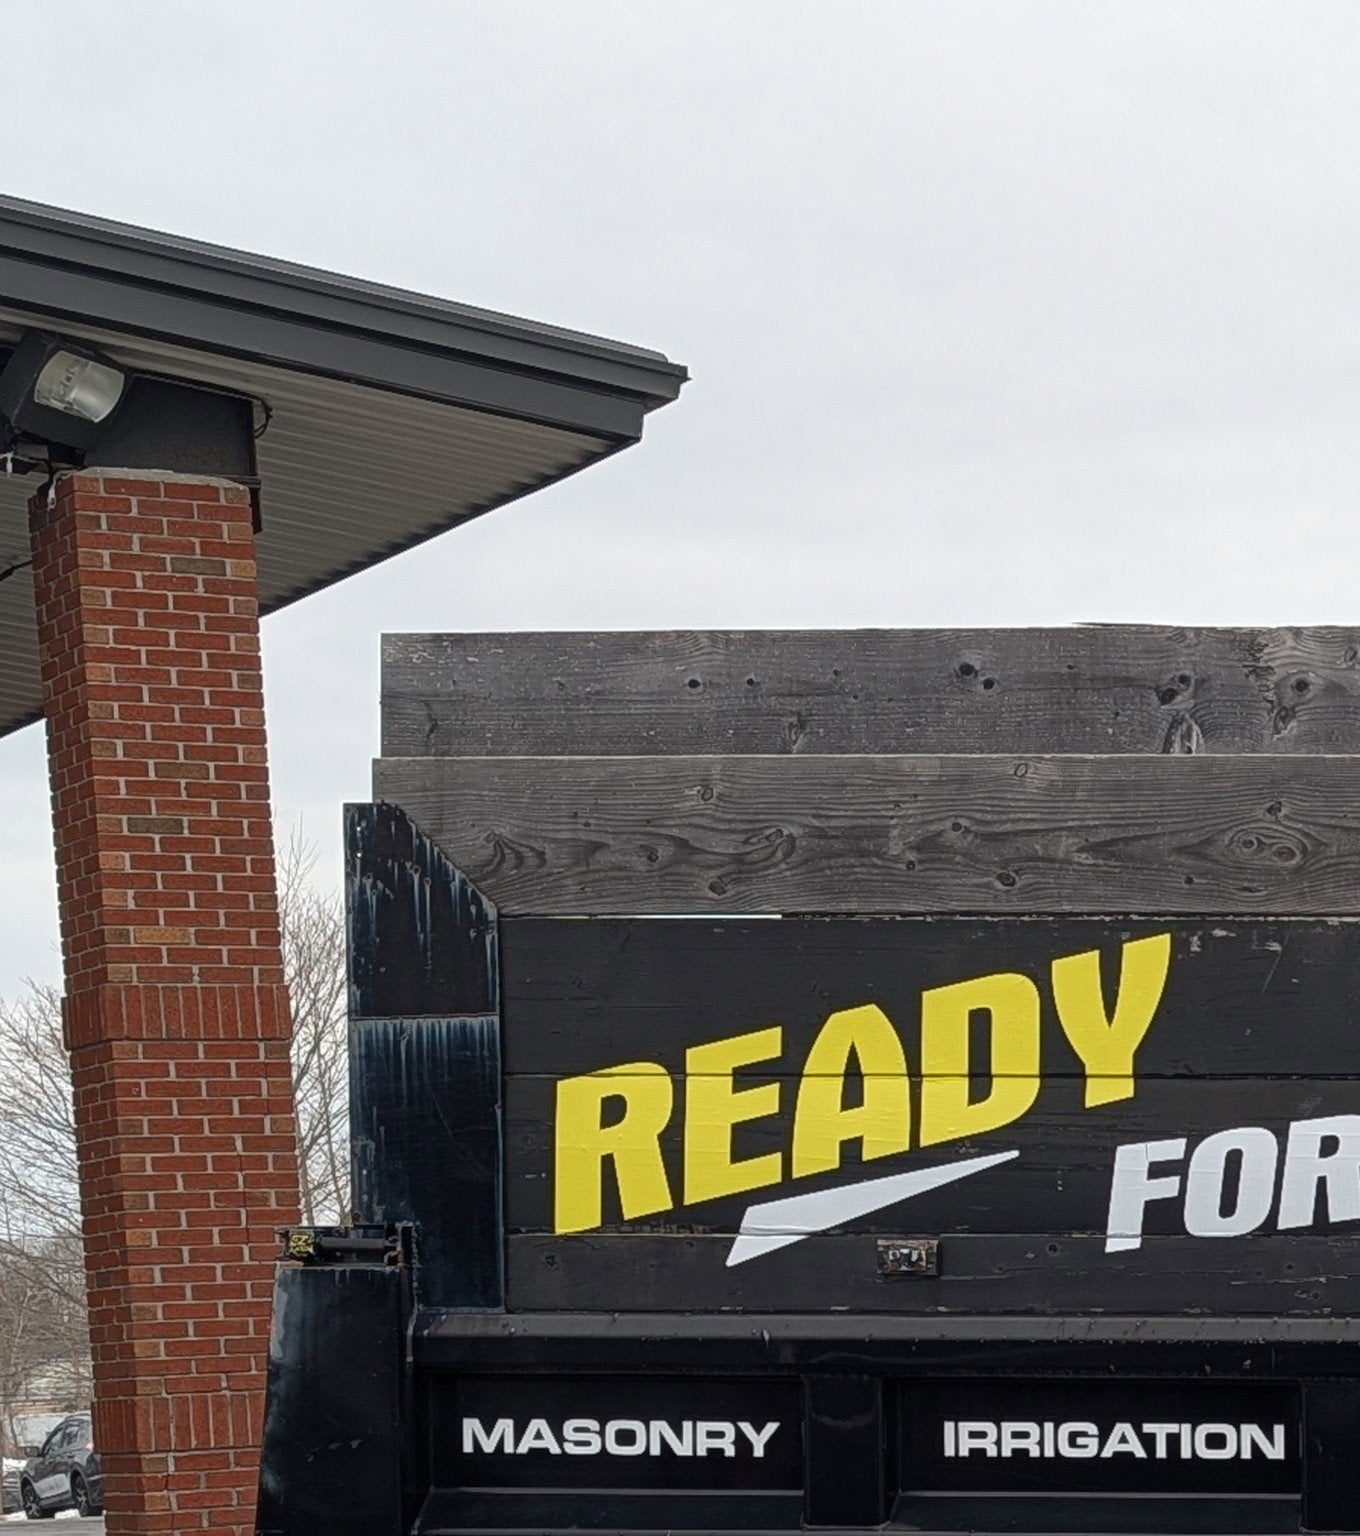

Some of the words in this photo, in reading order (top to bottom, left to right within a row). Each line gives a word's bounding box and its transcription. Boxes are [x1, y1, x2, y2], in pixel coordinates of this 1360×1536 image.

[555, 934, 1171, 1236] READY
[462, 1417, 781, 1458] MASONRY
[943, 1420, 1286, 1461] IRRIGATION
